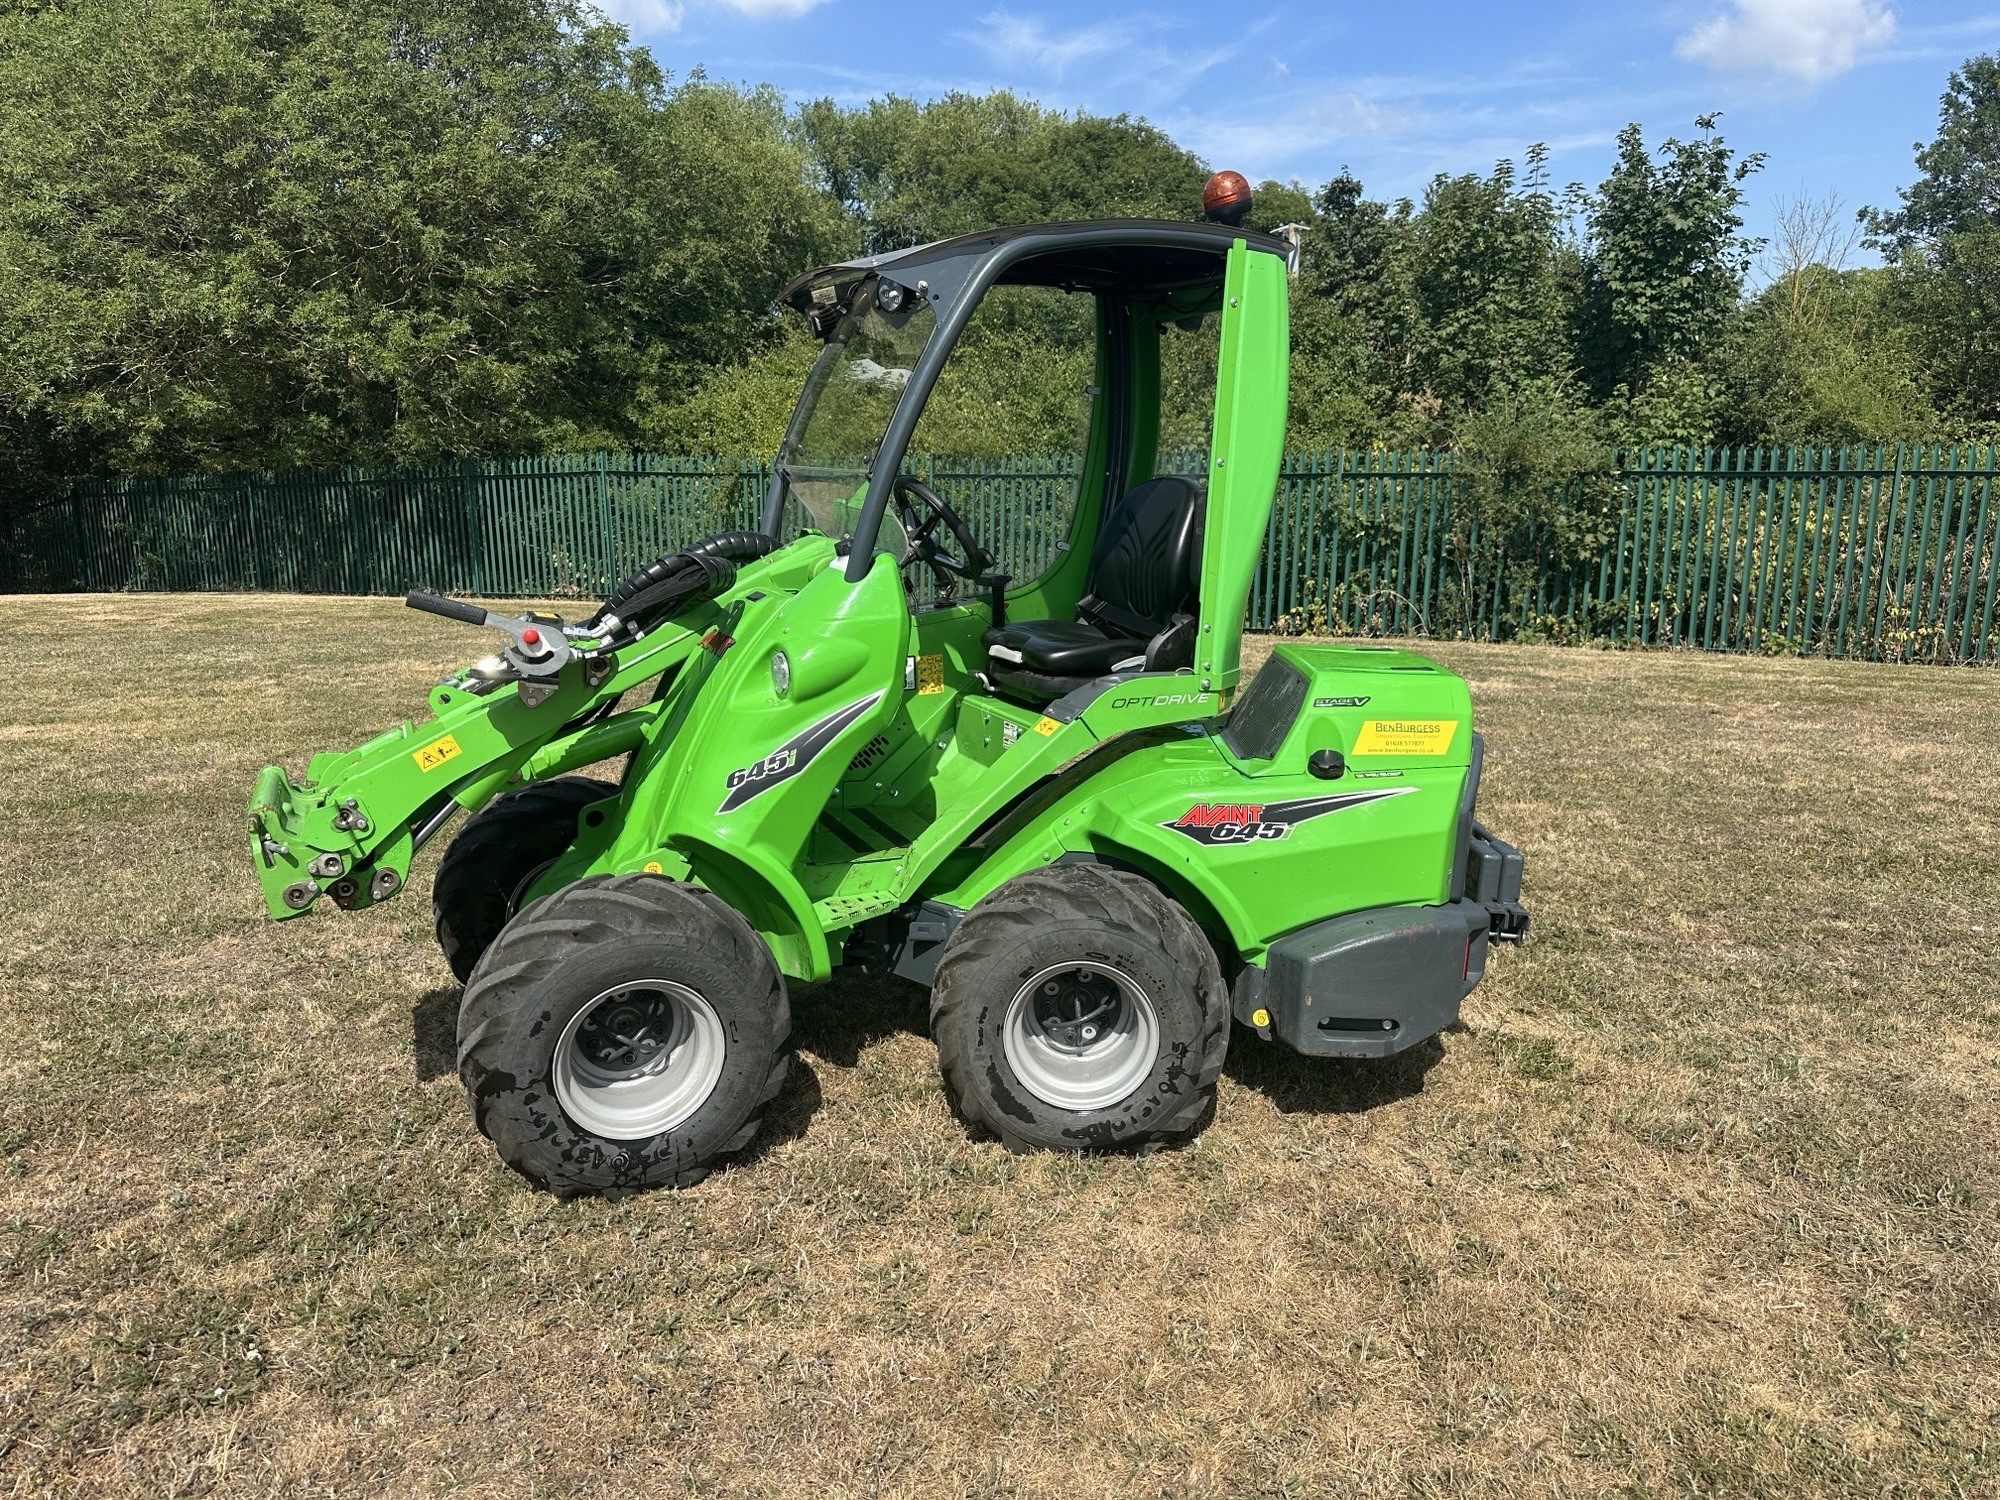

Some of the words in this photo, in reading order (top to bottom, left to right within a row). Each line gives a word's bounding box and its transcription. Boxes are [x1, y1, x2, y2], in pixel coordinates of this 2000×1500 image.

[1112, 693, 1210, 708] OPTIDRIVE
[1353, 697, 1369, 706] V
[726, 749, 797, 789] 645i
[1176, 803, 1262, 826] AVANT
